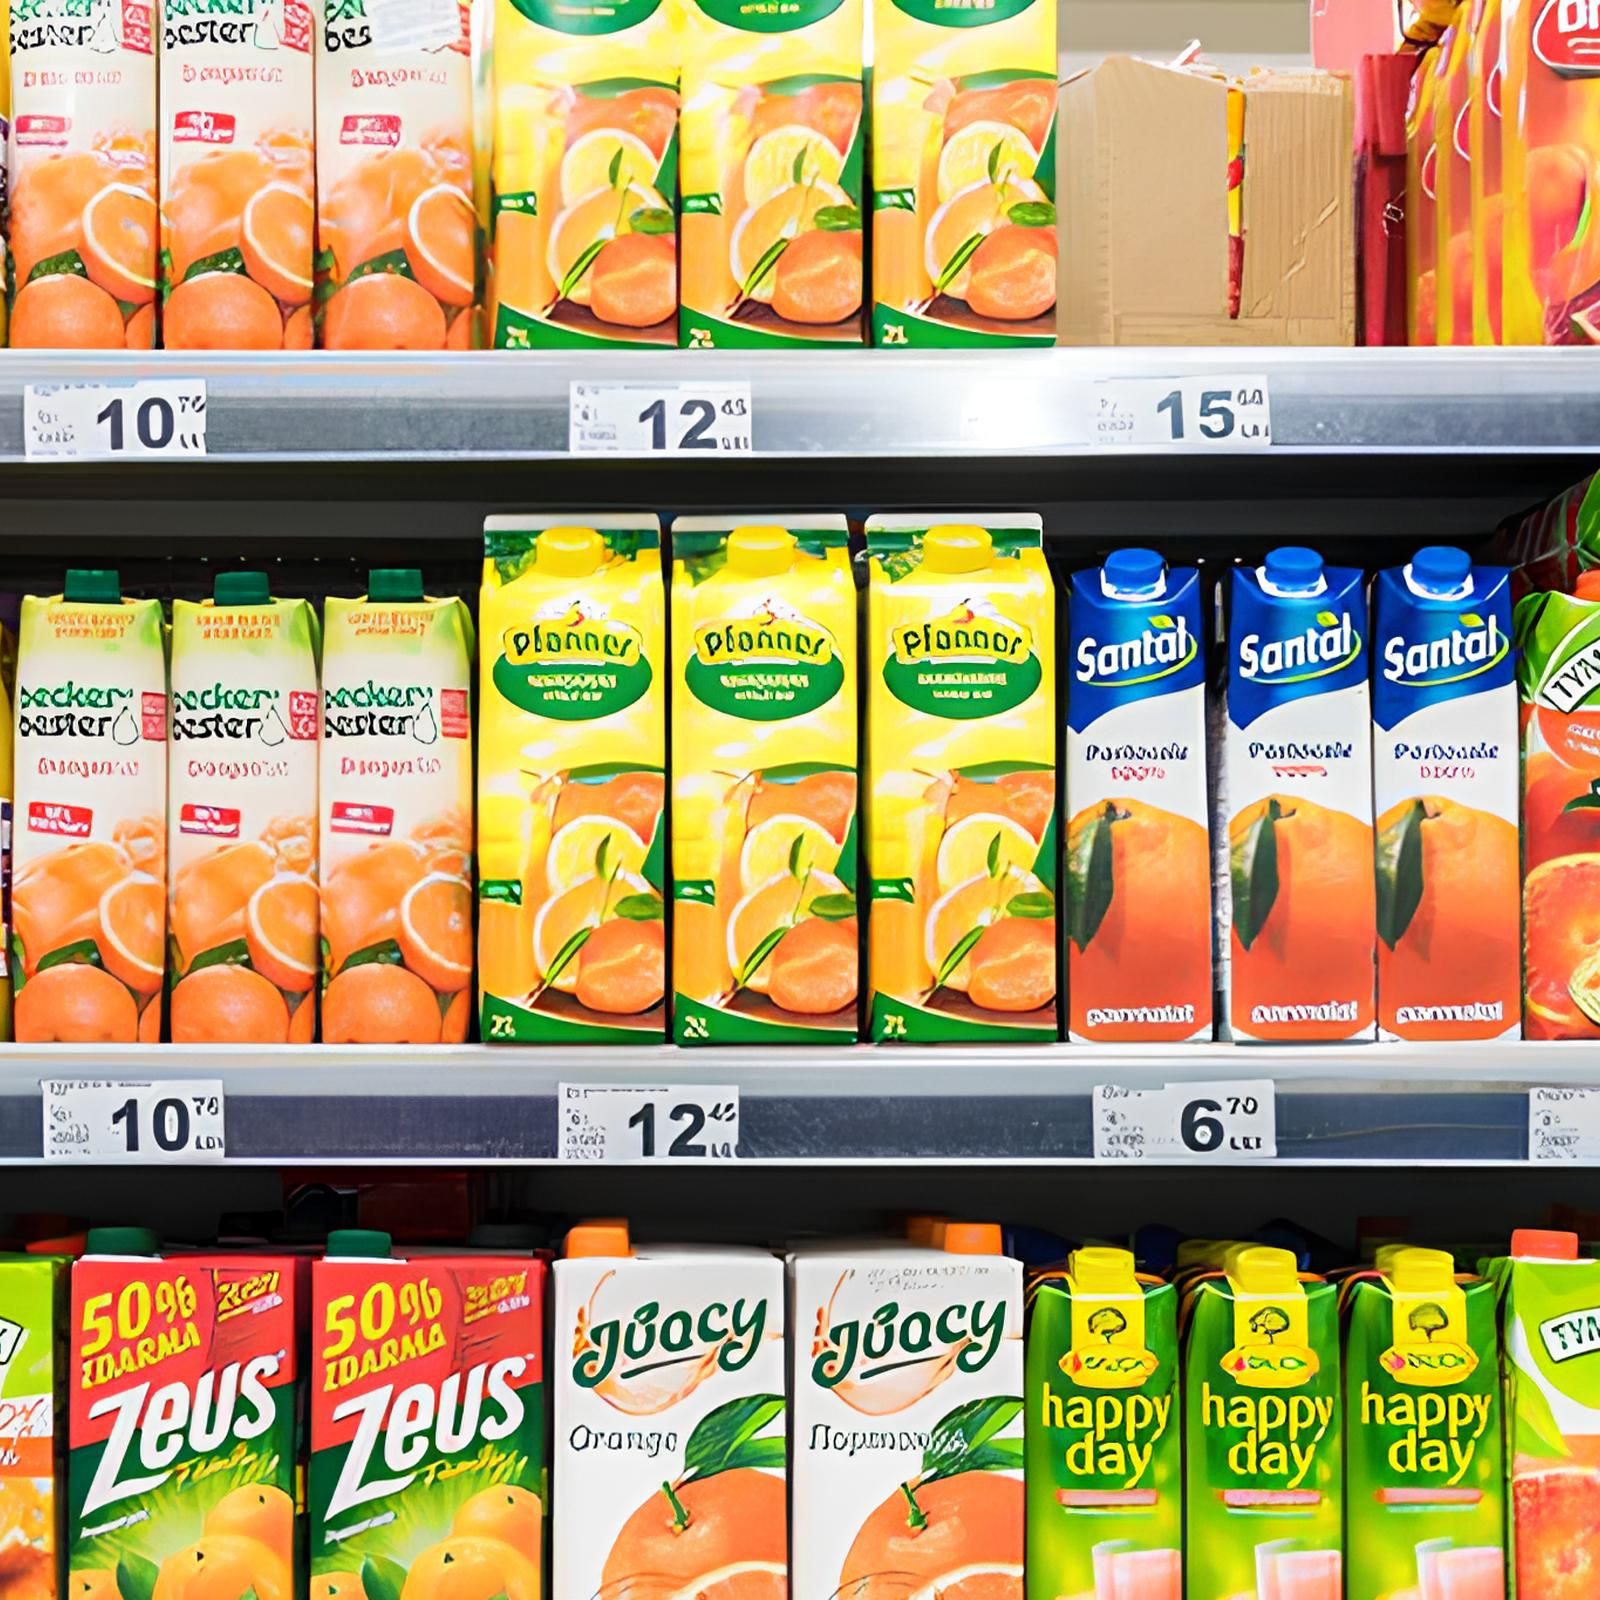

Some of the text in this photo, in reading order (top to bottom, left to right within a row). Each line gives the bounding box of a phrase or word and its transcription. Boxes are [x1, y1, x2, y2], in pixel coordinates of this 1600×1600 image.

[97, 398, 173, 450] 10
[639, 400, 717, 449] 12
[1157, 391, 1236, 438] 15
[111, 1099, 190, 1151] 10
[628, 1104, 706, 1156] 12
[1180, 1099, 1223, 1151] 6
[1042, 1382, 1171, 1438] happy
[1203, 1383, 1333, 1440] happy
[1361, 1382, 1492, 1436] happy
[1065, 1429, 1152, 1487] day
[1228, 1430, 1316, 1488] day
[1388, 1427, 1476, 1487] day
